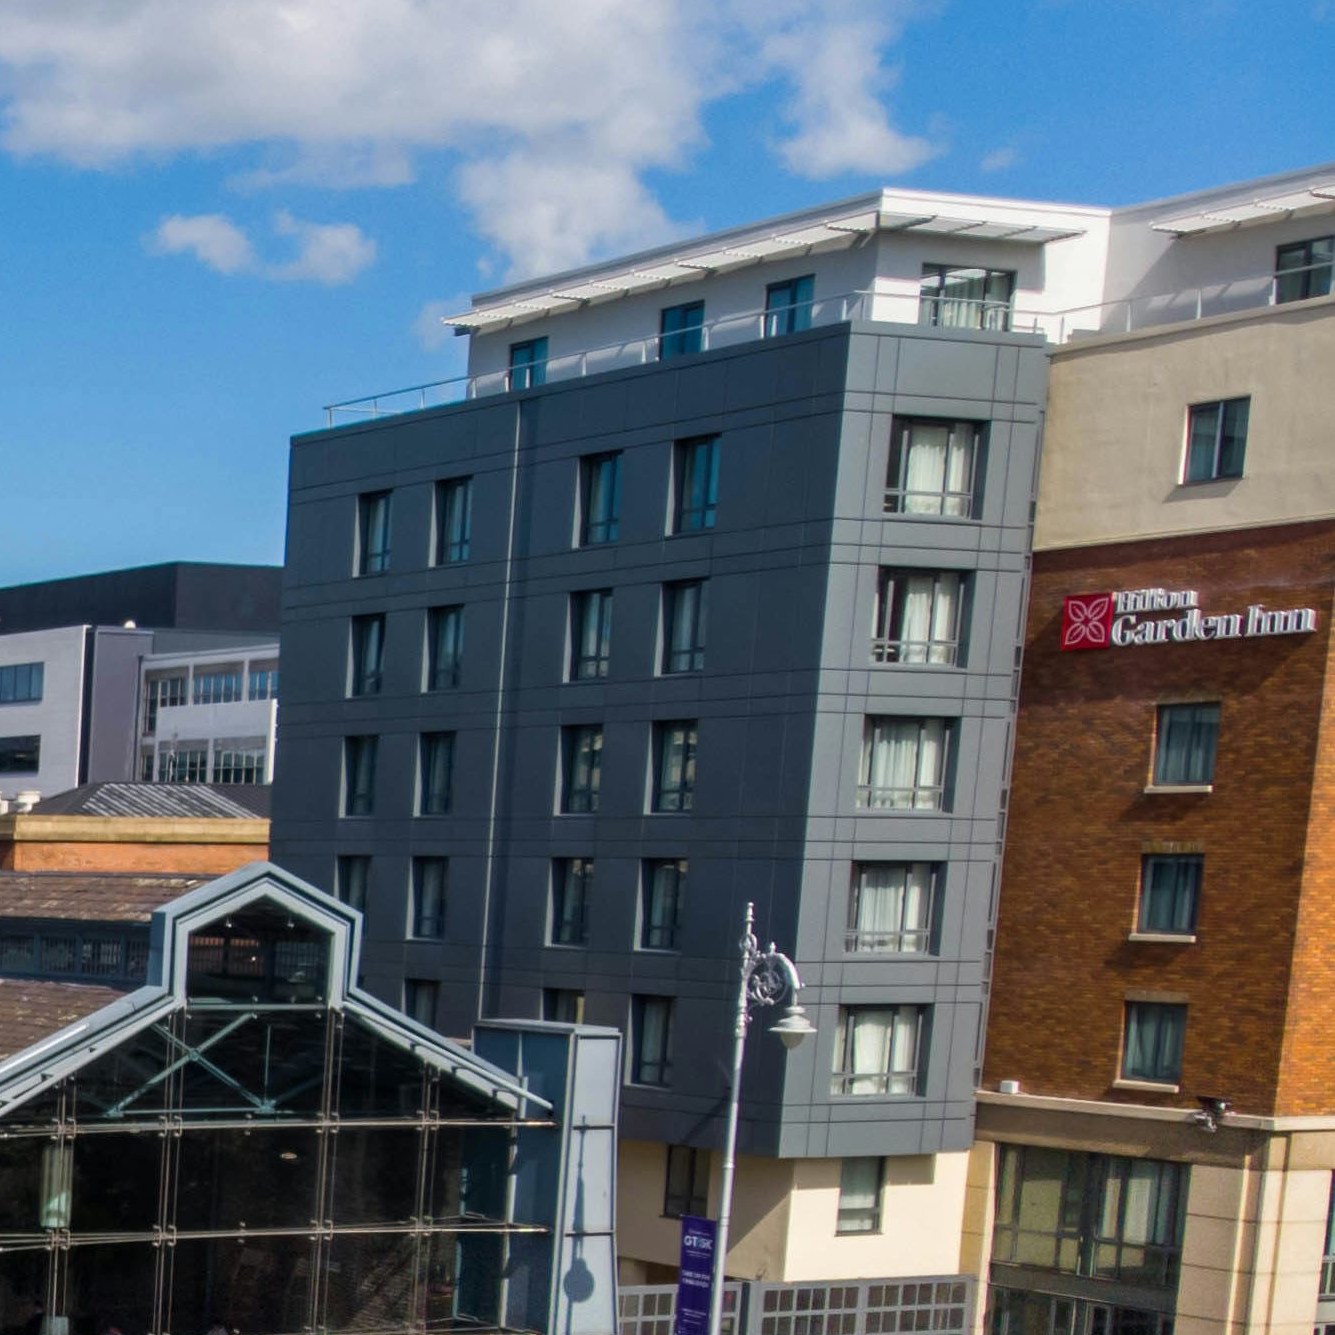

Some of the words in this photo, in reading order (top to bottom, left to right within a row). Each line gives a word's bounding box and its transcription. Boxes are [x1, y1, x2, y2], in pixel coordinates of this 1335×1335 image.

[1113, 588, 1199, 614] Hilton
[1111, 608, 1242, 647] Garden
[1244, 604, 1317, 637] Inn
